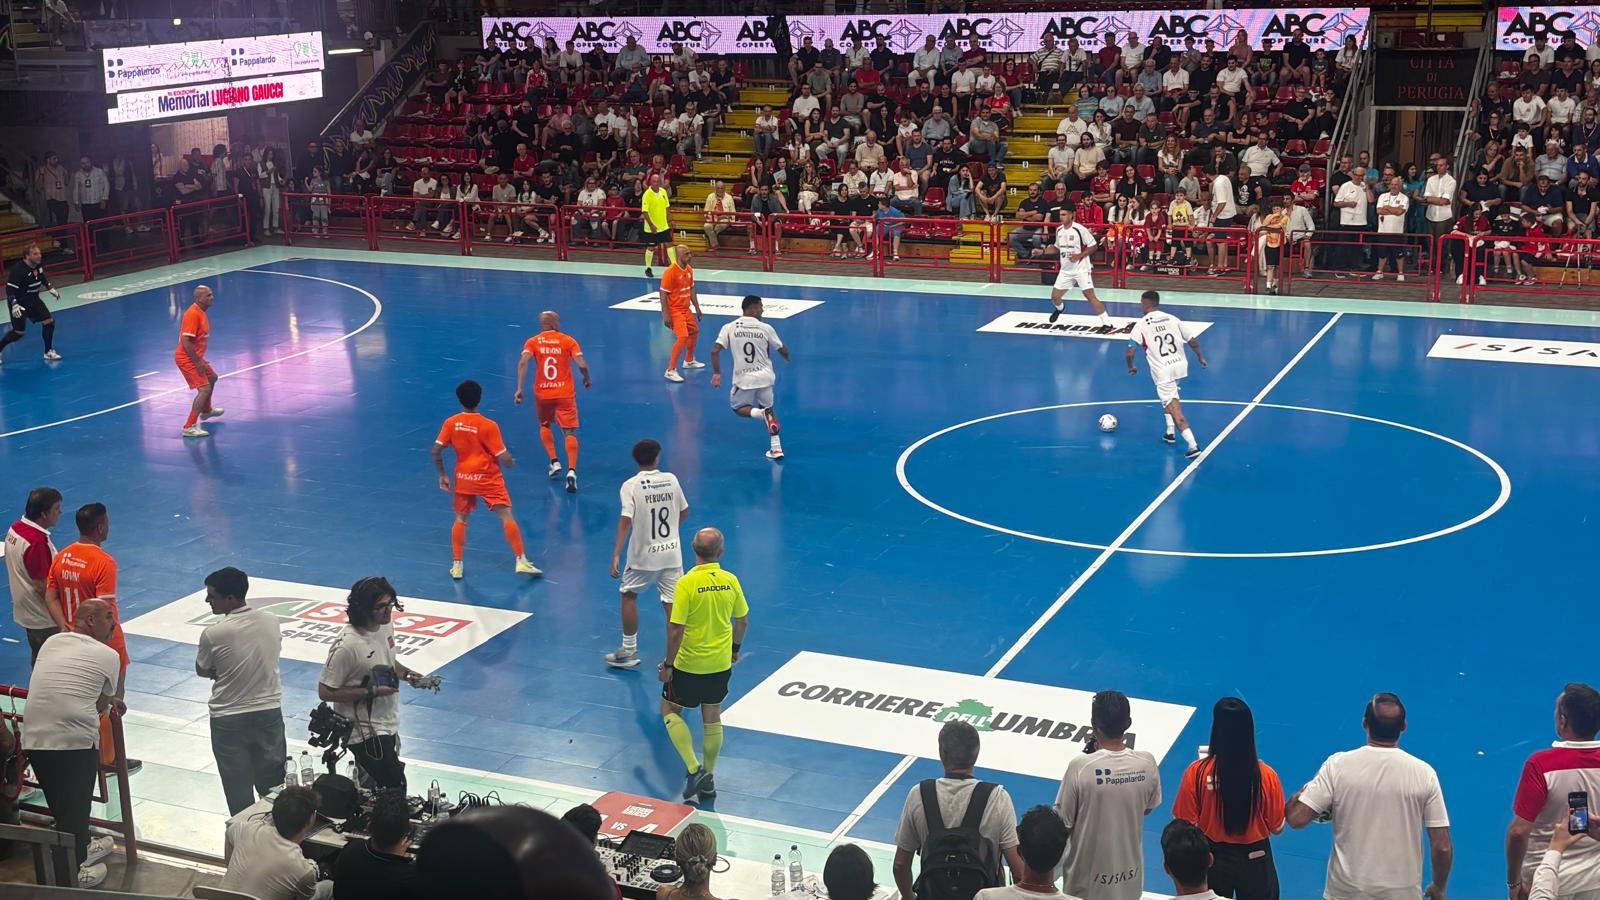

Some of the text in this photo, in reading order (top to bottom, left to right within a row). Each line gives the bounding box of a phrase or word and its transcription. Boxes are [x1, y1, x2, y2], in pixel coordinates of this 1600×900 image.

[487, 21, 531, 41] ABC
[570, 21, 617, 41] ABC
[656, 20, 702, 41] ABC
[736, 20, 769, 41] AB
[840, 19, 892, 41] ABC
[937, 17, 993, 40] ABC
[1040, 16, 1099, 39] ABC
[1148, 14, 1209, 39] ABC
[1262, 13, 1326, 37] ABC
[1503, 11, 1574, 37] ABC
[158, 90, 210, 113] Memorial
[252, 81, 284, 102] GAUCCI
[1397, 86, 1464, 100] PERUGIA
[743, 341, 756, 364] 9
[1154, 333, 1178, 357] 23
[543, 356, 558, 381] 6
[644, 492, 674, 504] PERUGINI
[650, 506, 671, 540] 18
[697, 585, 731, 594] DIADORA
[64, 587, 80, 622] 11
[307, 605, 461, 635] SSA
[777, 681, 944, 719] CORRIERE
[989, 712, 1137, 750] UMBRA
[1105, 774, 1146, 785] Pappalardo
